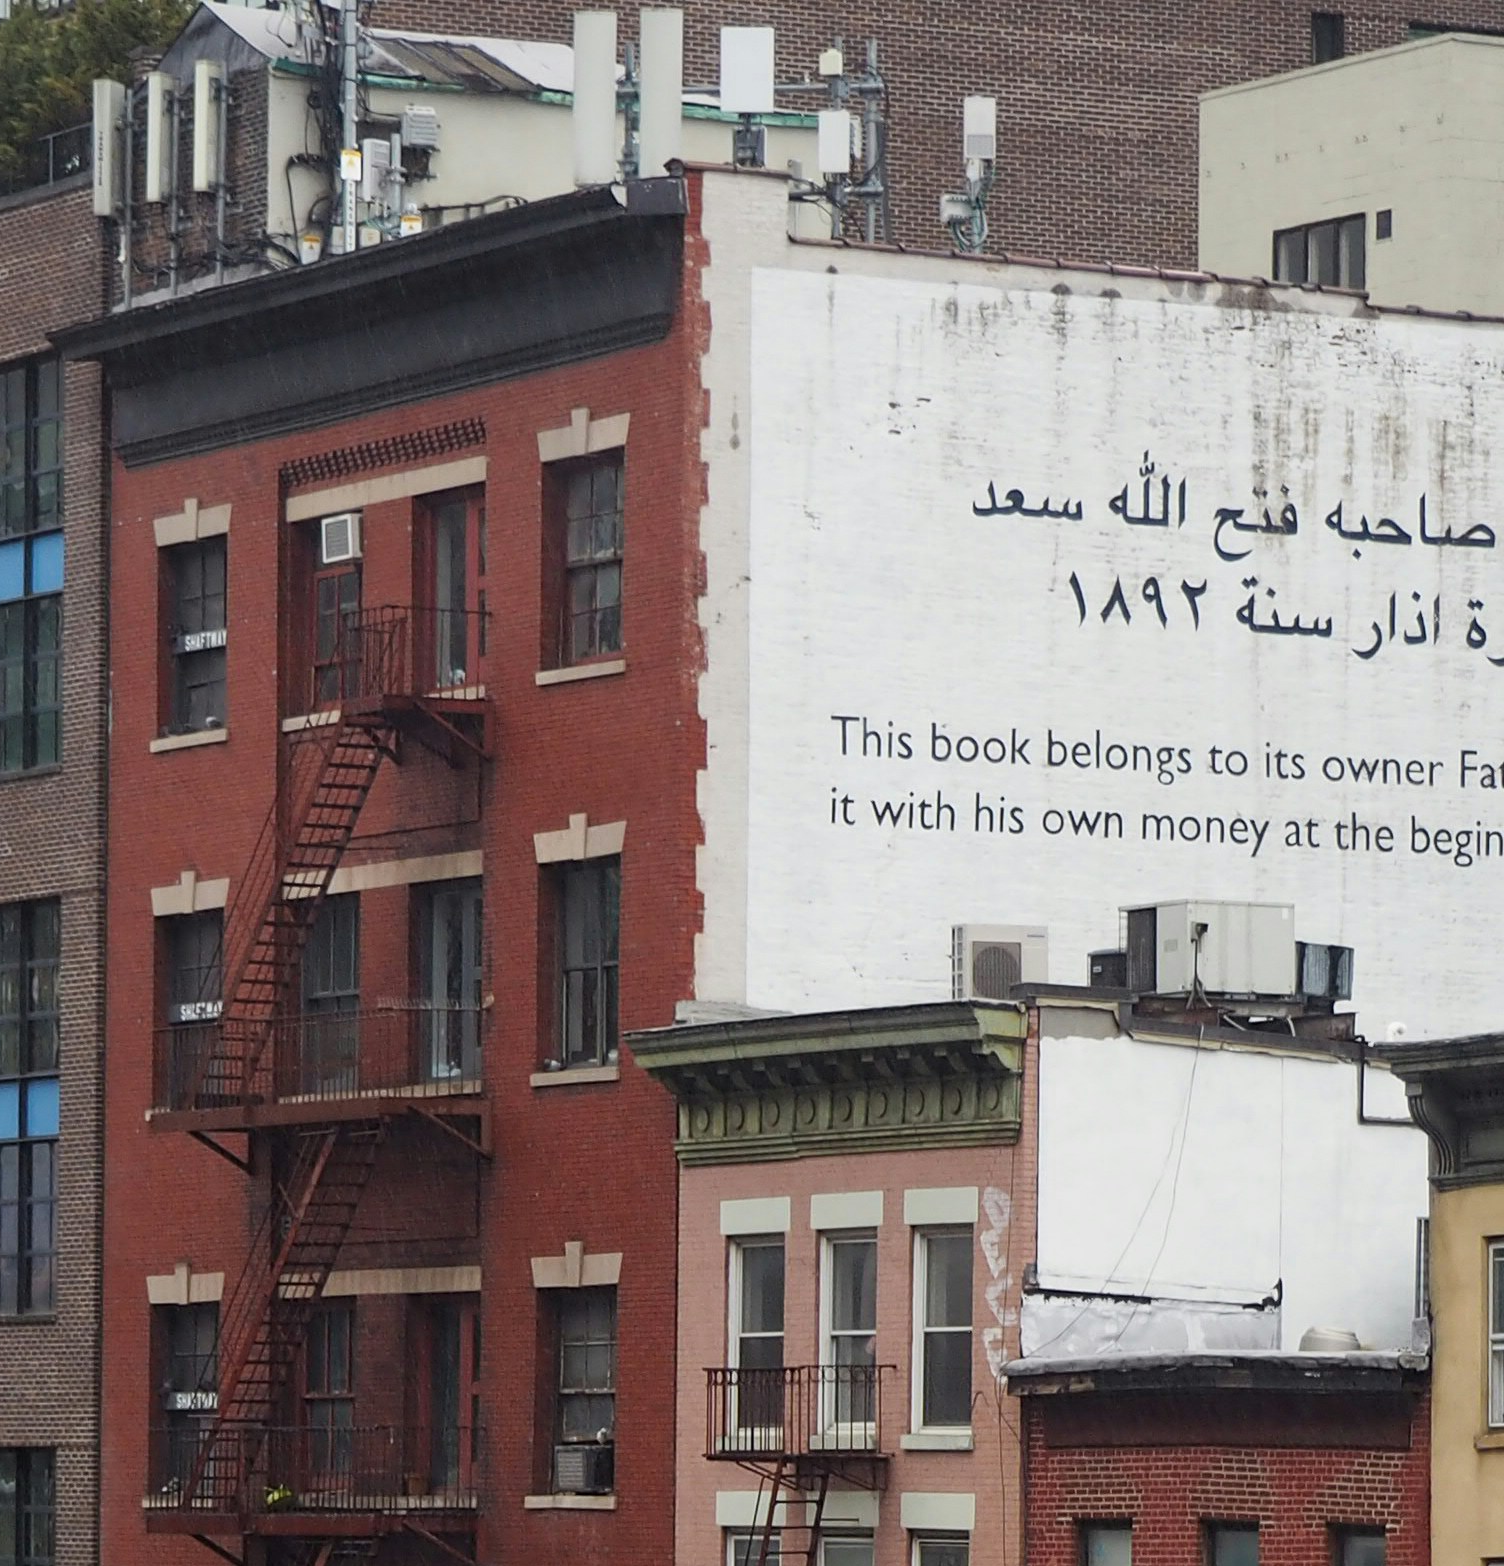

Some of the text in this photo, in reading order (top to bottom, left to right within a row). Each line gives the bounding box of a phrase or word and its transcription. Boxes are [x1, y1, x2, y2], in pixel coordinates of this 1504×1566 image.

[972, 481, 1083, 521] سعد
[1212, 483, 1298, 561] فتح
[1325, 493, 1496, 561] صاحبه
[1068, 571, 1207, 632] ١٨٩٢
[1236, 575, 1332, 637] سنة
[1352, 591, 1440, 660] اذار
[831, 716, 913, 760] This
[930, 722, 1031, 766] book
[1047, 729, 1193, 786] belongs
[1209, 745, 1248, 777] to
[1263, 742, 1306, 780] its
[1322, 757, 1444, 788] owner
[830, 787, 855, 826] it
[870, 790, 955, 832] with
[973, 792, 1024, 834] his
[1041, 807, 1124, 839] own
[1141, 813, 1270, 857] money
[1284, 818, 1320, 848] at
[1334, 813, 1394, 853] the
